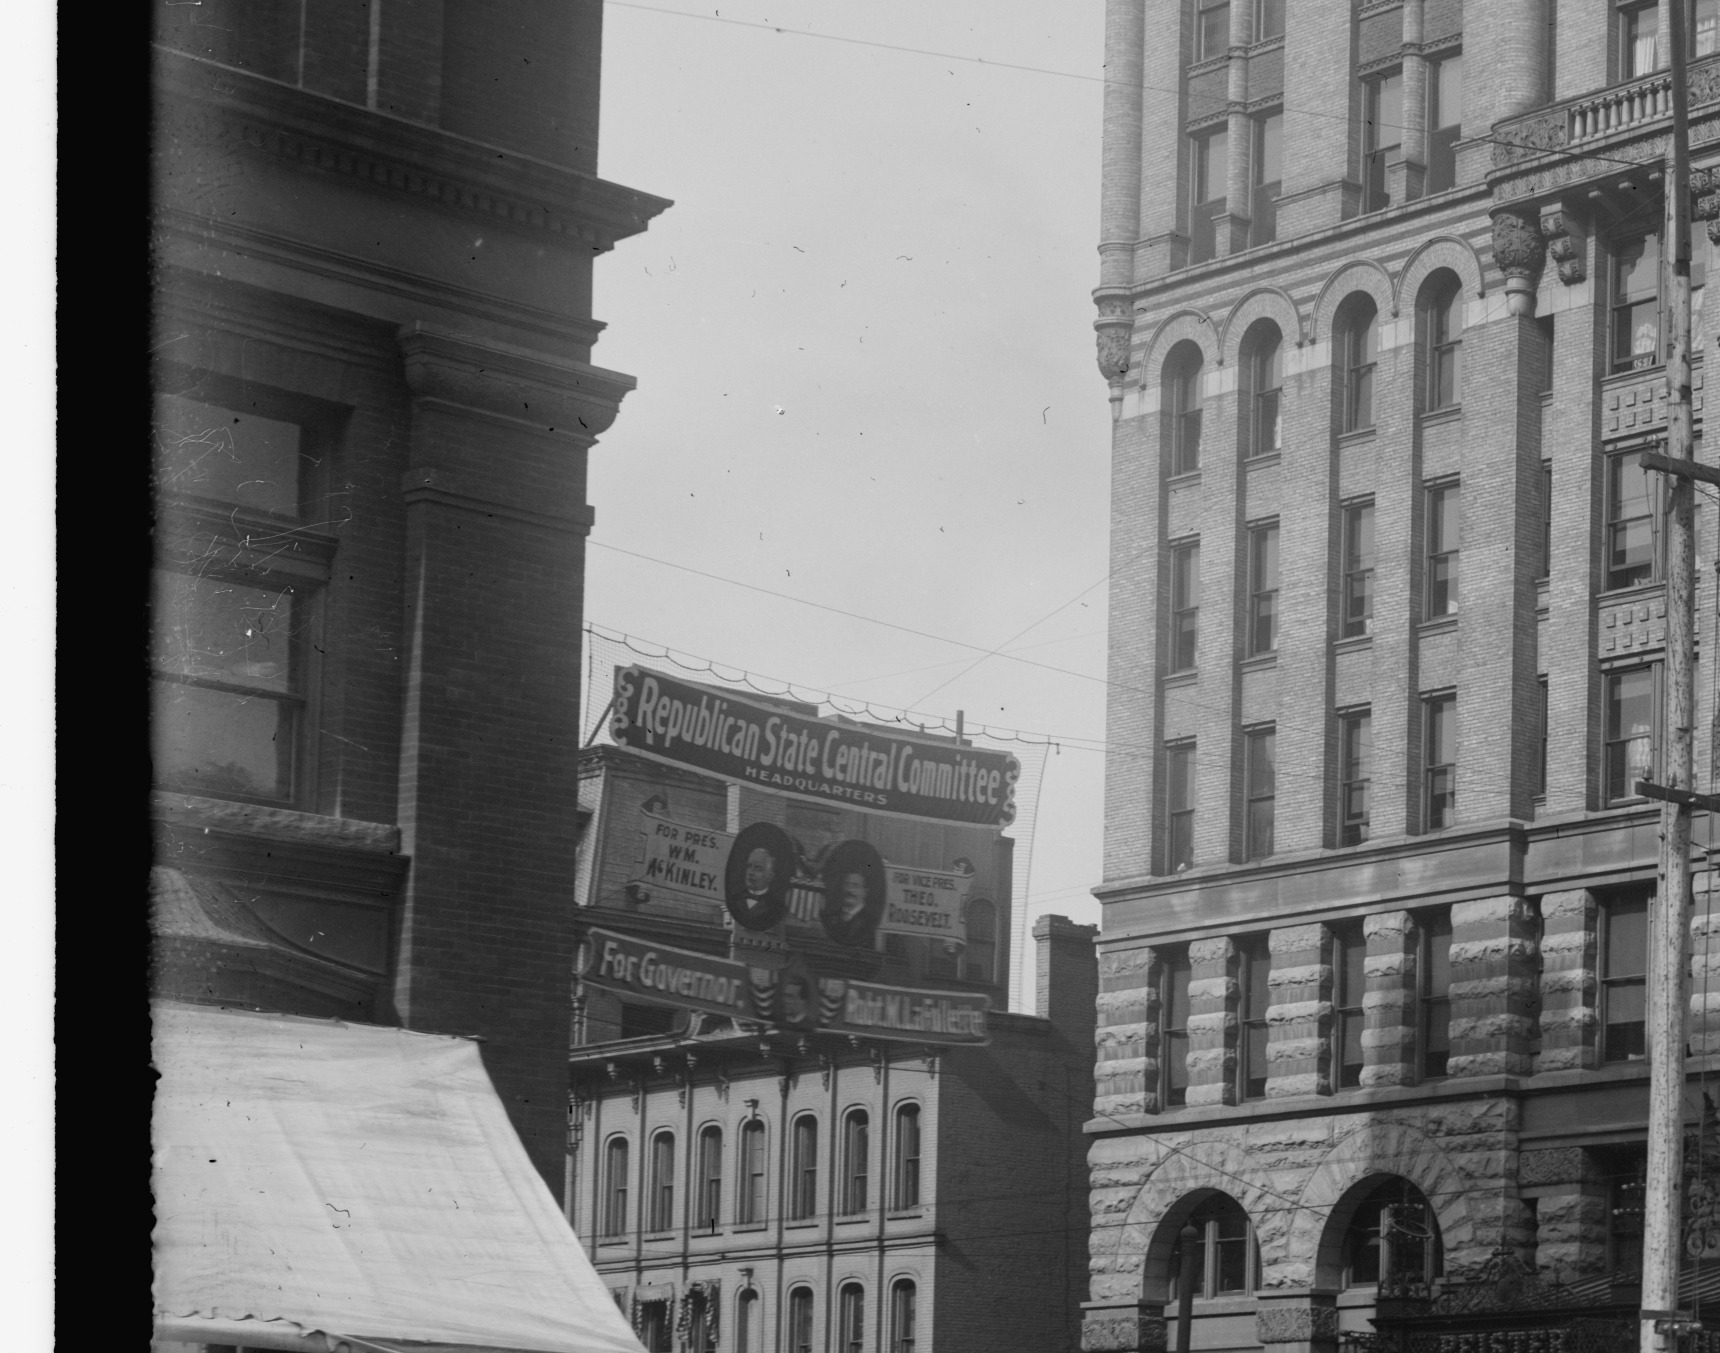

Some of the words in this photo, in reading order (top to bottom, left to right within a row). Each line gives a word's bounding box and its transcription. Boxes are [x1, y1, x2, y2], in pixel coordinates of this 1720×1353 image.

[636, 676, 761, 761] Republican
[760, 716, 819, 775] State
[820, 730, 898, 790] Central
[897, 745, 1001, 805] Committee
[745, 765, 889, 806] HEADQUARTERS
[655, 823, 679, 841] FOR
[684, 831, 719, 850] PRES.
[668, 844, 700, 865] WM.
[599, 940, 639, 982] For
[639, 951, 745, 1010] Governor.
